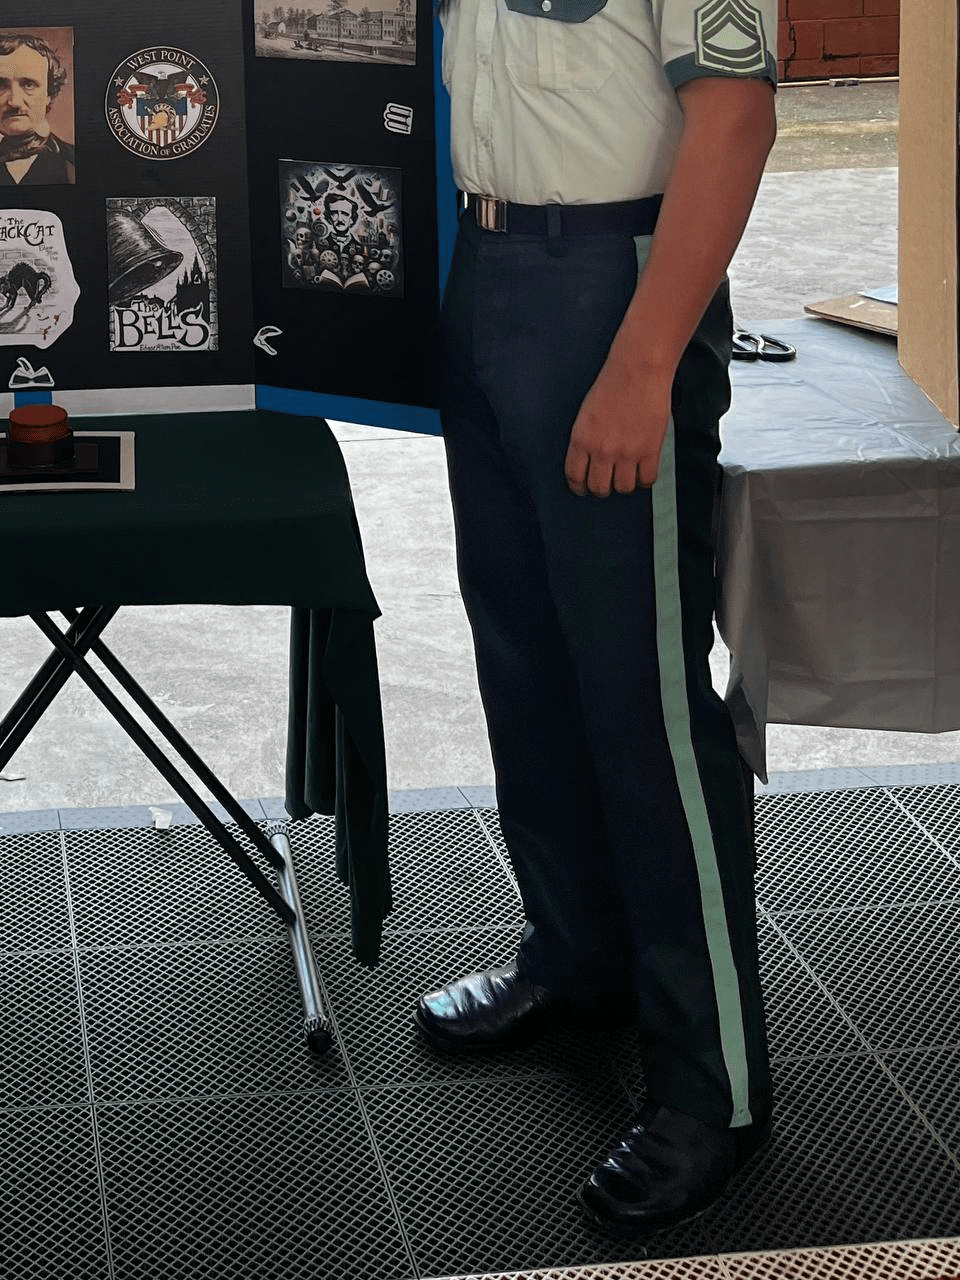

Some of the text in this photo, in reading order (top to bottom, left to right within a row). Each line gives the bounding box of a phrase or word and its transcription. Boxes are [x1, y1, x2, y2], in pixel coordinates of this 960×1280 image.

[126, 50, 196, 70] WEST POINT
[108, 105, 216, 156] ASSOCIATION OF GRADUATES
[7, 217, 25, 225] The
[131, 300, 160, 313] The
[113, 302, 210, 348] BELLS
